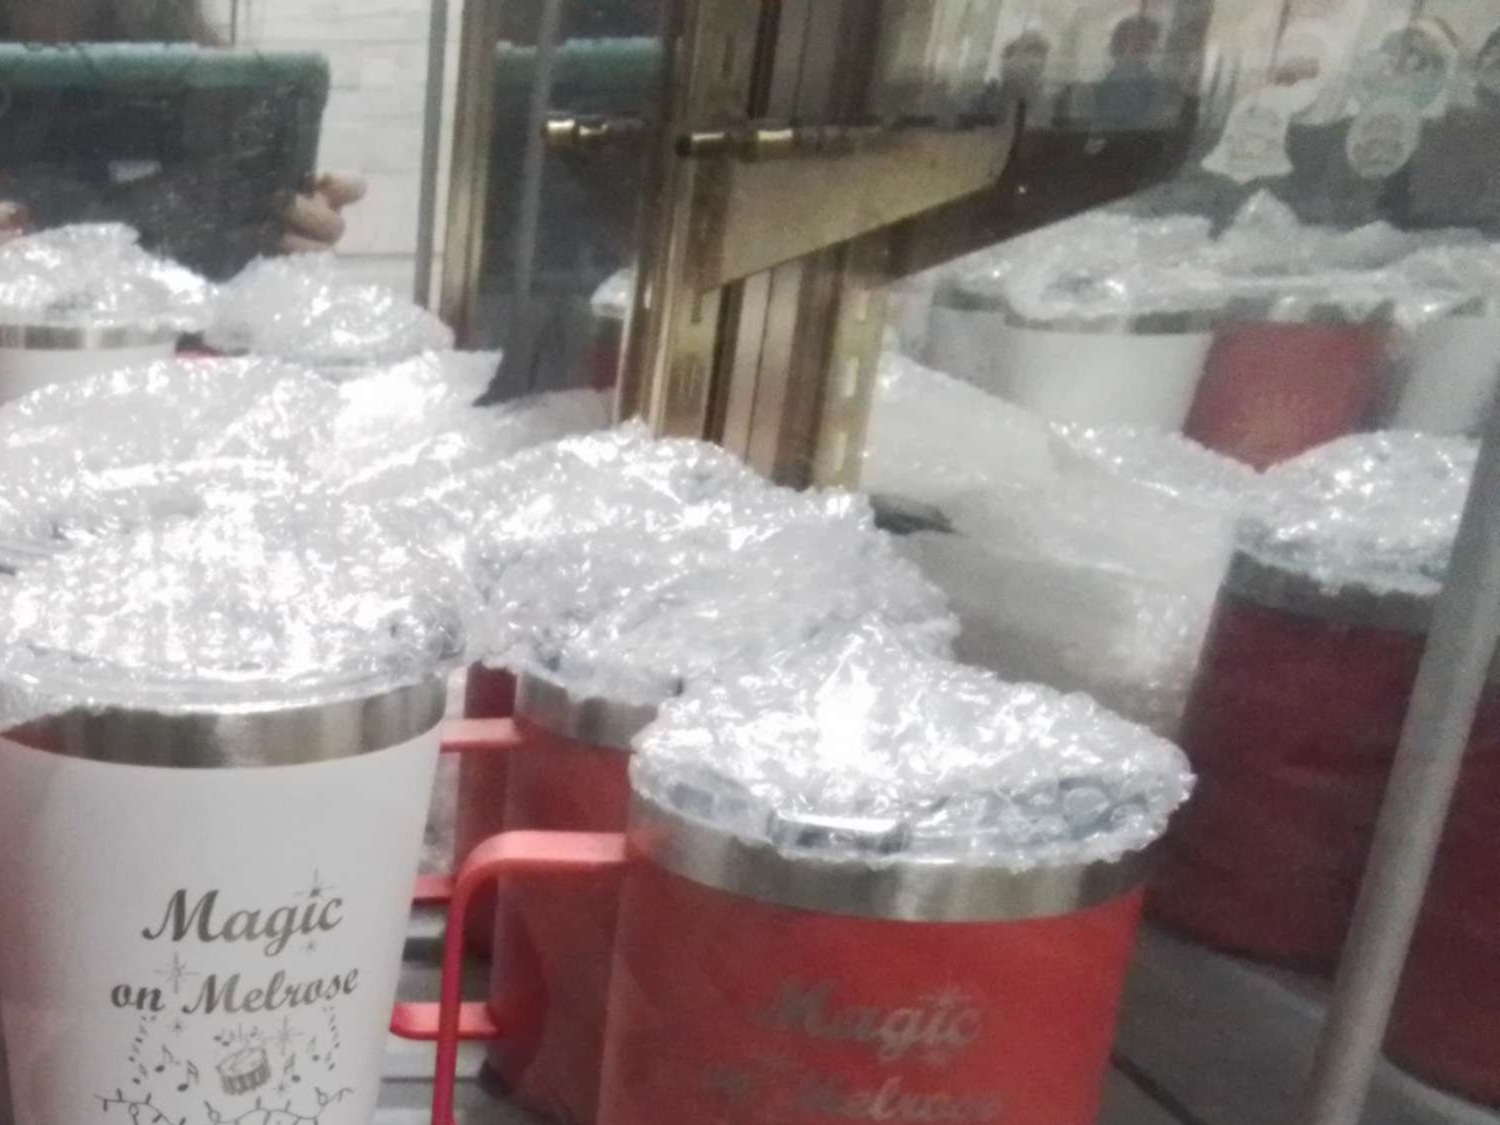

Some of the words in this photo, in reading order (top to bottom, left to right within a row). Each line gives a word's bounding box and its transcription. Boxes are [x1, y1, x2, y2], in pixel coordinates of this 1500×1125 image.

[142, 888, 343, 957] Magic
[111, 983, 165, 1012] on
[182, 968, 359, 1015] Melrose
[753, 975, 982, 1064] Magic
